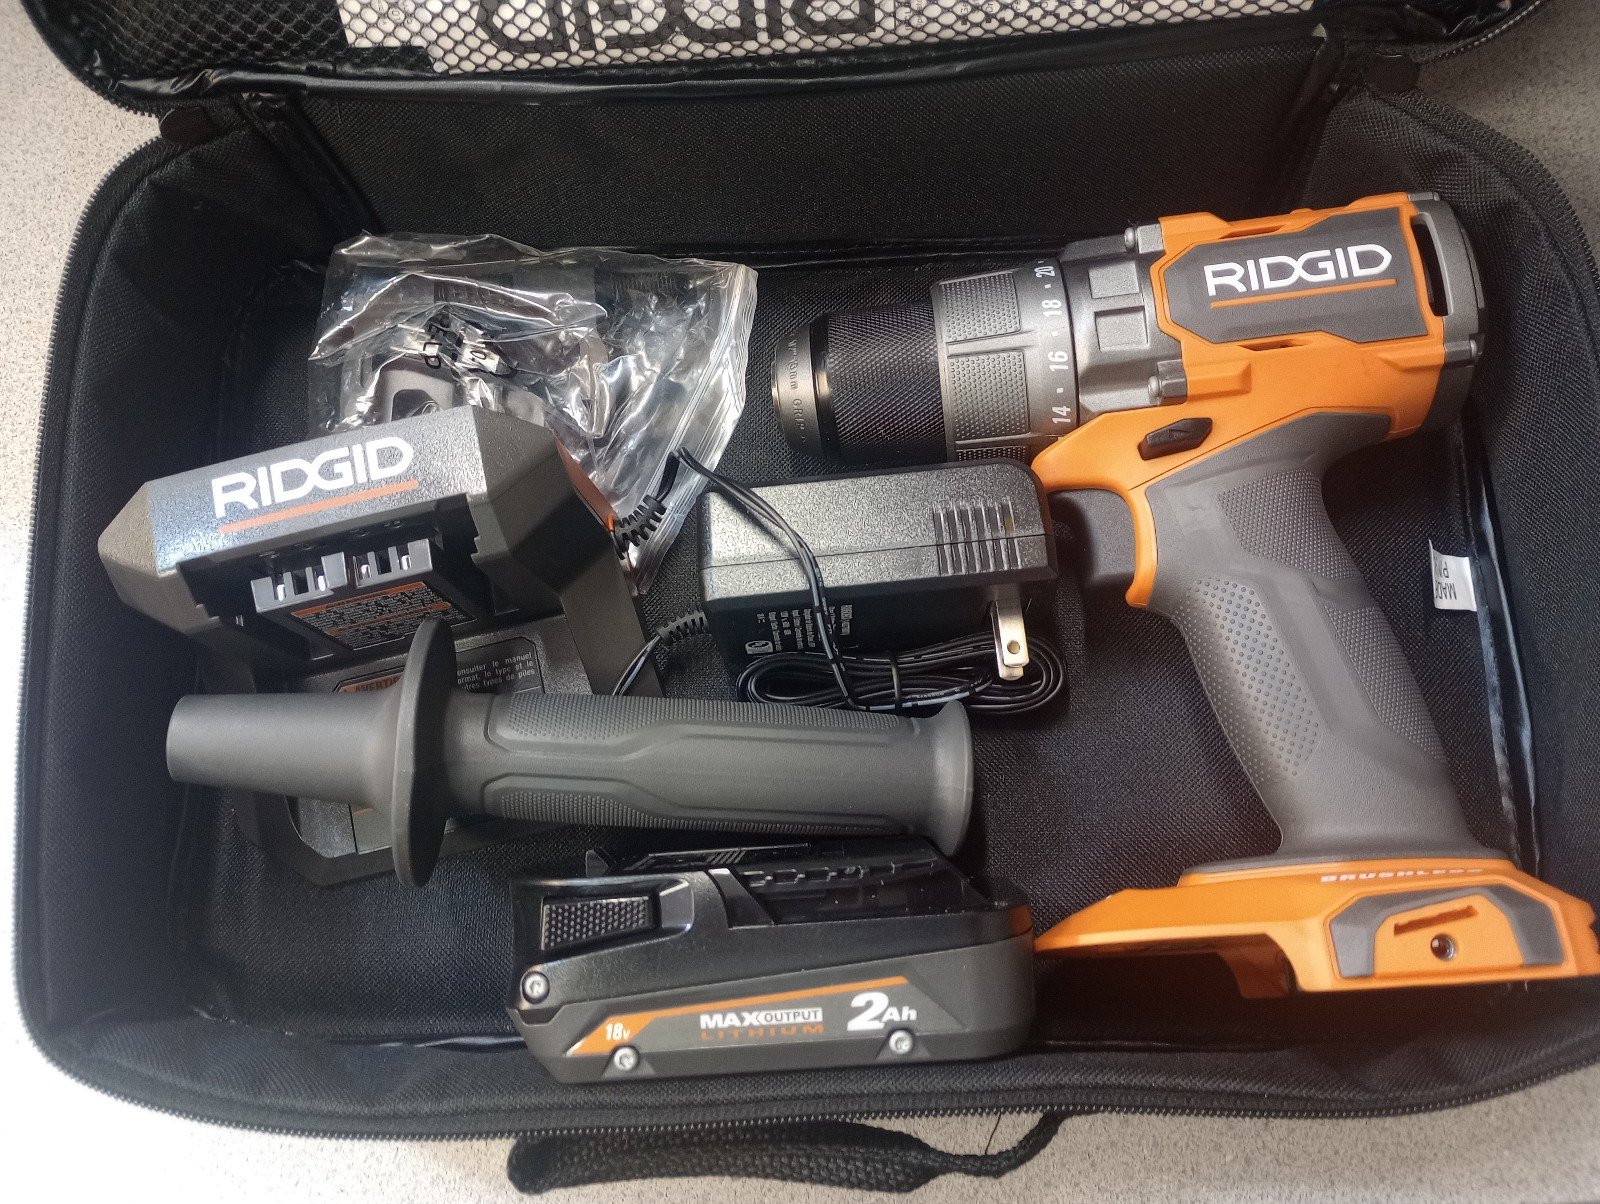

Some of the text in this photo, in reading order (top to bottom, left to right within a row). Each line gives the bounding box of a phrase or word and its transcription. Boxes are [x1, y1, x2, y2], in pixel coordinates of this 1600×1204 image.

[1034, 265, 1057, 279] 20
[1204, 244, 1393, 296] RIDGID
[1041, 299, 1064, 318] 18
[1047, 351, 1070, 372] 16
[1052, 405, 1072, 424] 14
[211, 436, 415, 519] RIDGID
[700, 1011, 759, 1029] MAX
[763, 1009, 820, 1023] OUTPUT
[700, 1024, 825, 1040] LITHIUM
